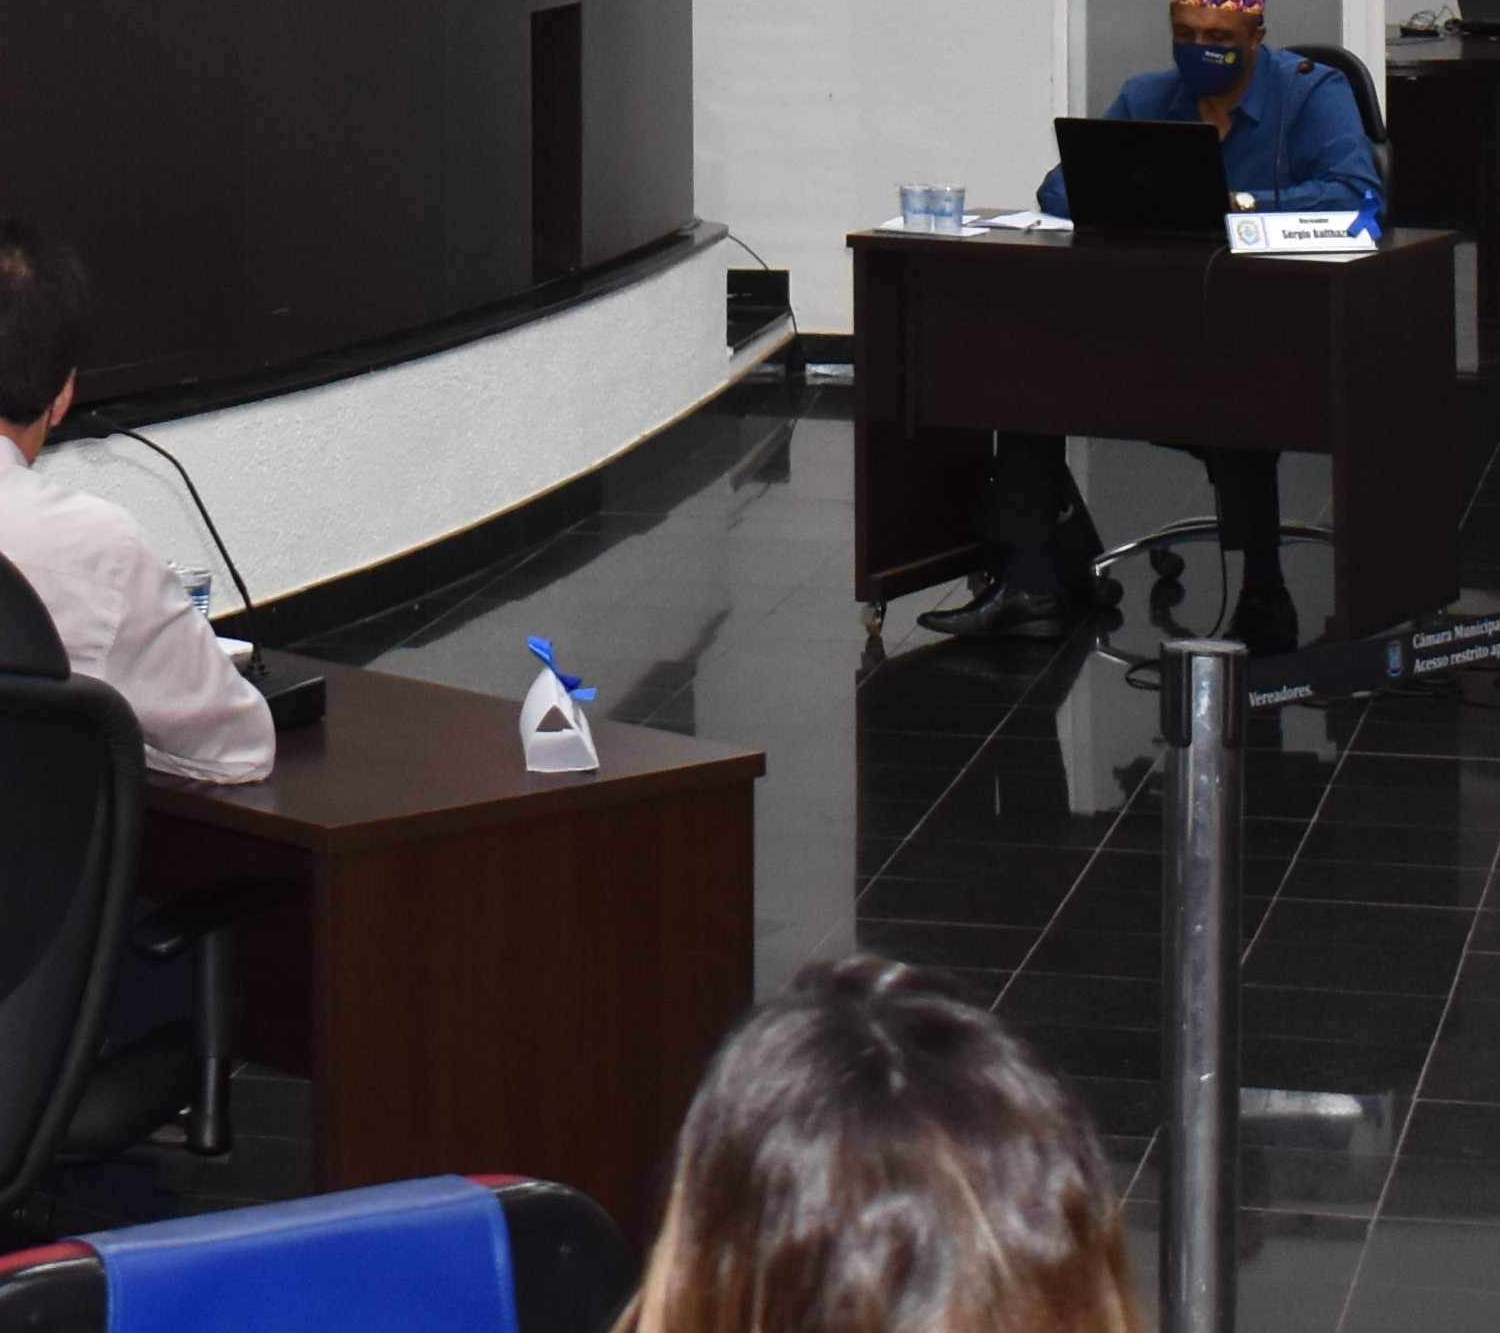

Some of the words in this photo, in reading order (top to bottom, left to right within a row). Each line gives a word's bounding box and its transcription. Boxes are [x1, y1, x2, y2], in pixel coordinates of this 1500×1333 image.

[1412, 628, 1453, 649] Câmara
[1413, 651, 1449, 674] Acesso
[1449, 640, 1489, 664] restrito
[1248, 683, 1315, 709] Vereadores.
